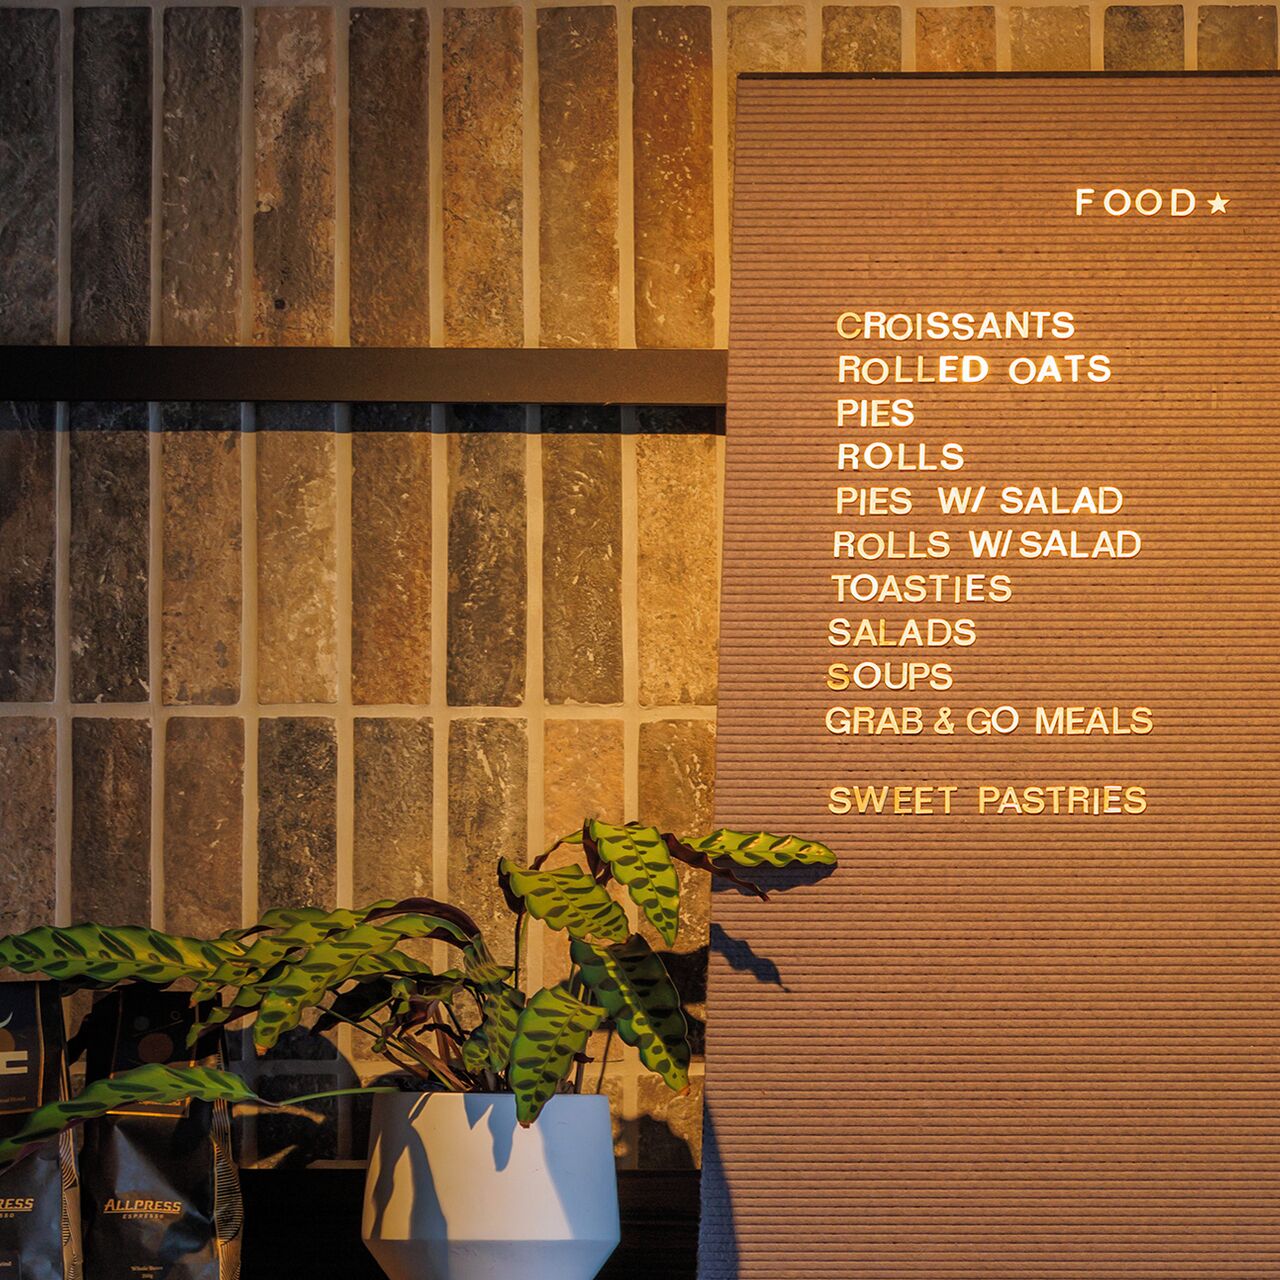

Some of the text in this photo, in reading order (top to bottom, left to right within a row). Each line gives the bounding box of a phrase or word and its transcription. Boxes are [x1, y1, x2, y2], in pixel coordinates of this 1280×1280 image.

[1075, 187, 1196, 217] FOOD
[836, 310, 1075, 341] CROISSANTS
[838, 354, 990, 385] ROLLED
[1008, 354, 1112, 385] OATS
[837, 398, 915, 427] PIES
[837, 441, 965, 471] ROLLS
[836, 486, 913, 516] PIES
[999, 486, 1123, 515] SALAD
[833, 530, 951, 560] ROLLS
[830, 573, 1012, 603] TOASTIES
[828, 617, 977, 647] SALADS
[826, 661, 953, 690] SOUPS
[825, 706, 923, 735] GRAB
[933, 706, 955, 735] &
[966, 705, 1020, 735] GO
[1035, 706, 1153, 735] MEALS
[828, 785, 958, 814] SWEET
[979, 785, 1147, 815] PASTRIES
[103, 1198, 182, 1212] ALLPRESS
